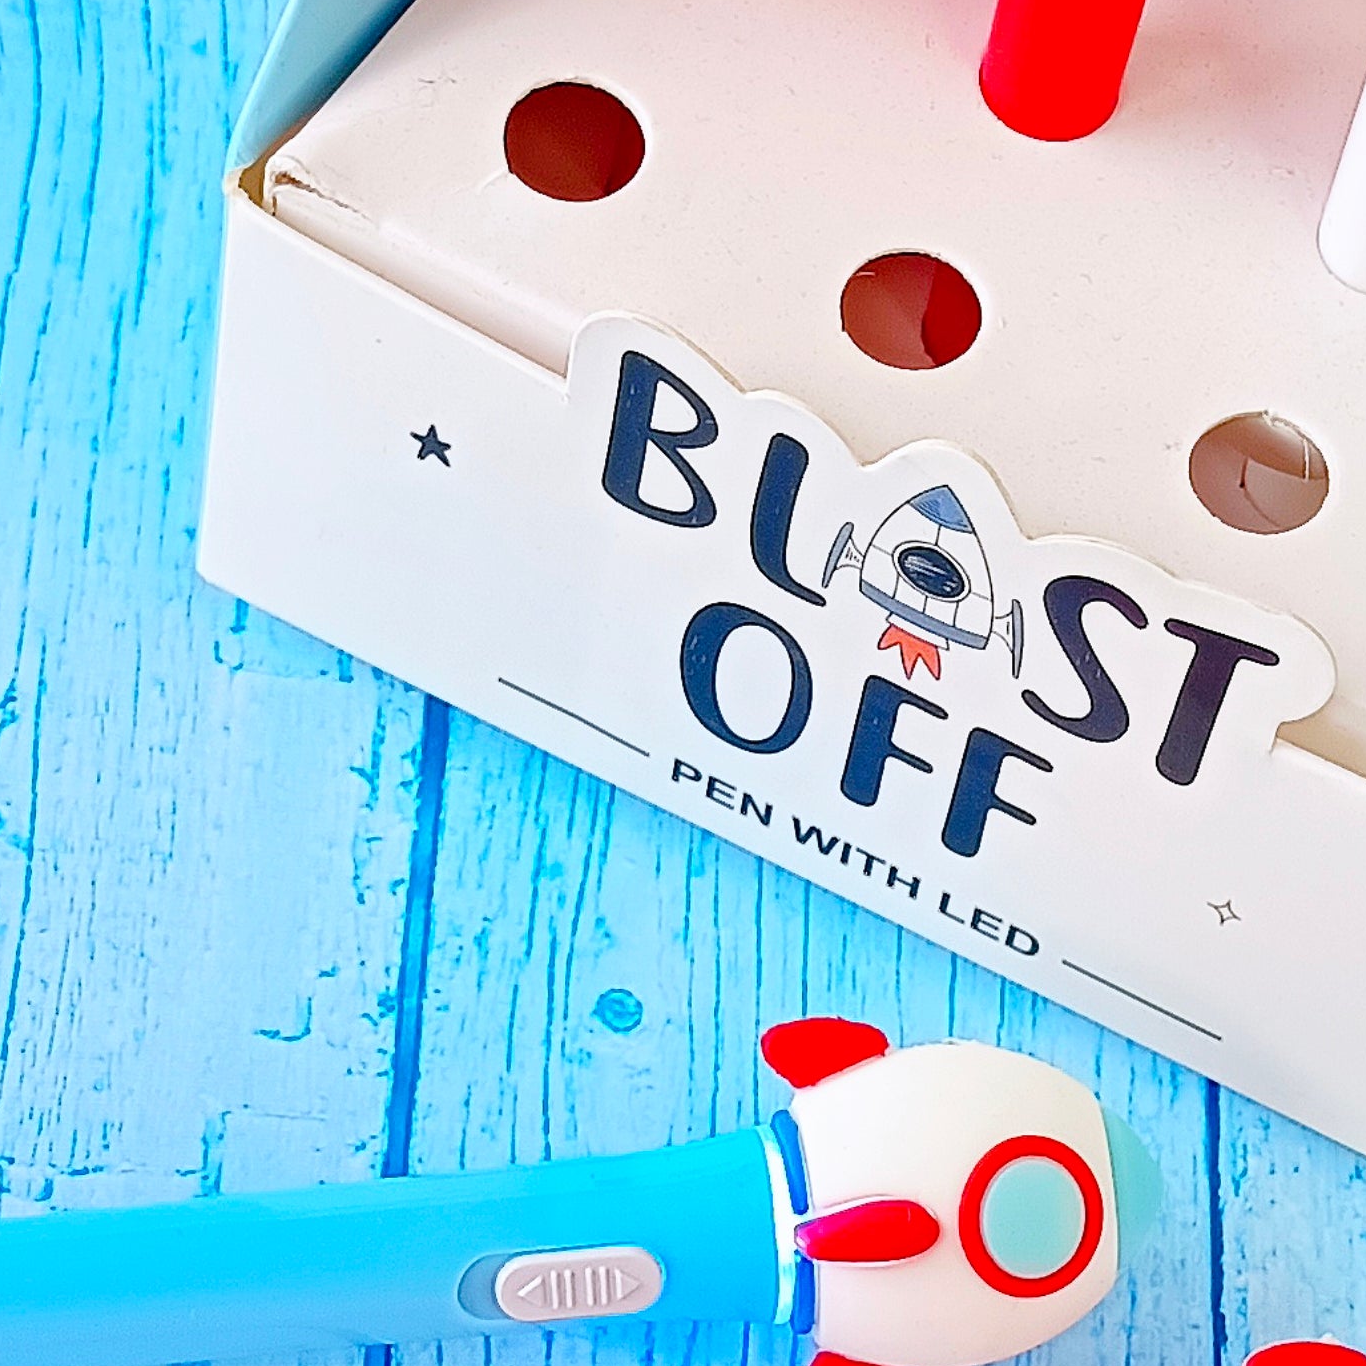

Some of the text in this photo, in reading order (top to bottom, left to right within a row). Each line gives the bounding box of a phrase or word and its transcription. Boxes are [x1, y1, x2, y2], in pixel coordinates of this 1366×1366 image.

[680, 602, 1054, 858] OFF
[671, 758, 1039, 956] PEN WITH LED
